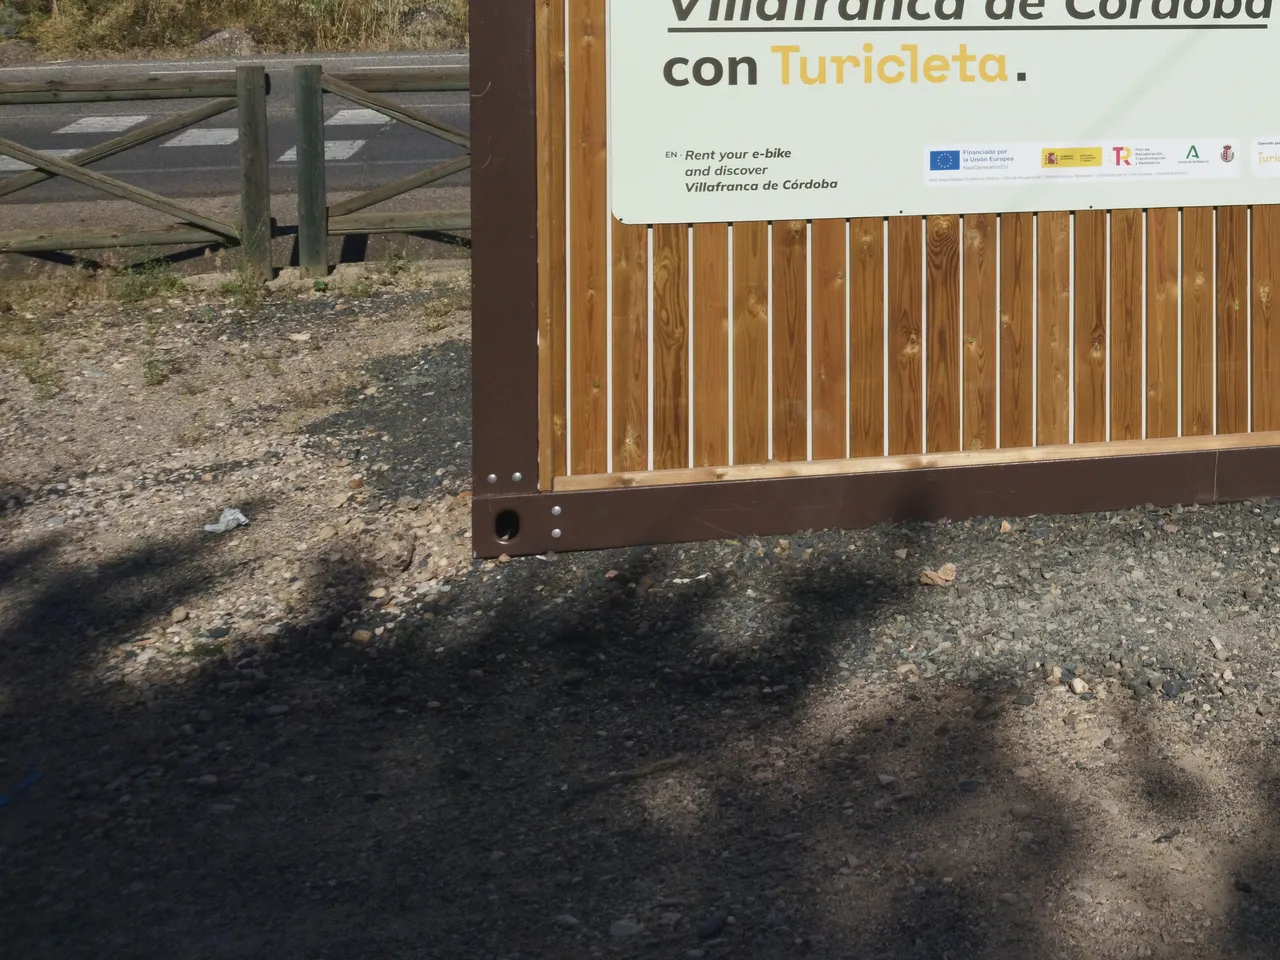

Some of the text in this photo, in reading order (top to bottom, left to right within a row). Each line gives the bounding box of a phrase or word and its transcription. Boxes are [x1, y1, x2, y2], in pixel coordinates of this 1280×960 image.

[663, 43, 1026, 87] con Turicleta.
[685, 150, 716, 160] Rent
[719, 152, 749, 162] your
[752, 148, 791, 159] e-bike
[685, 166, 768, 176] and discover
[686, 179, 838, 192] Villafranca de Córdoba
